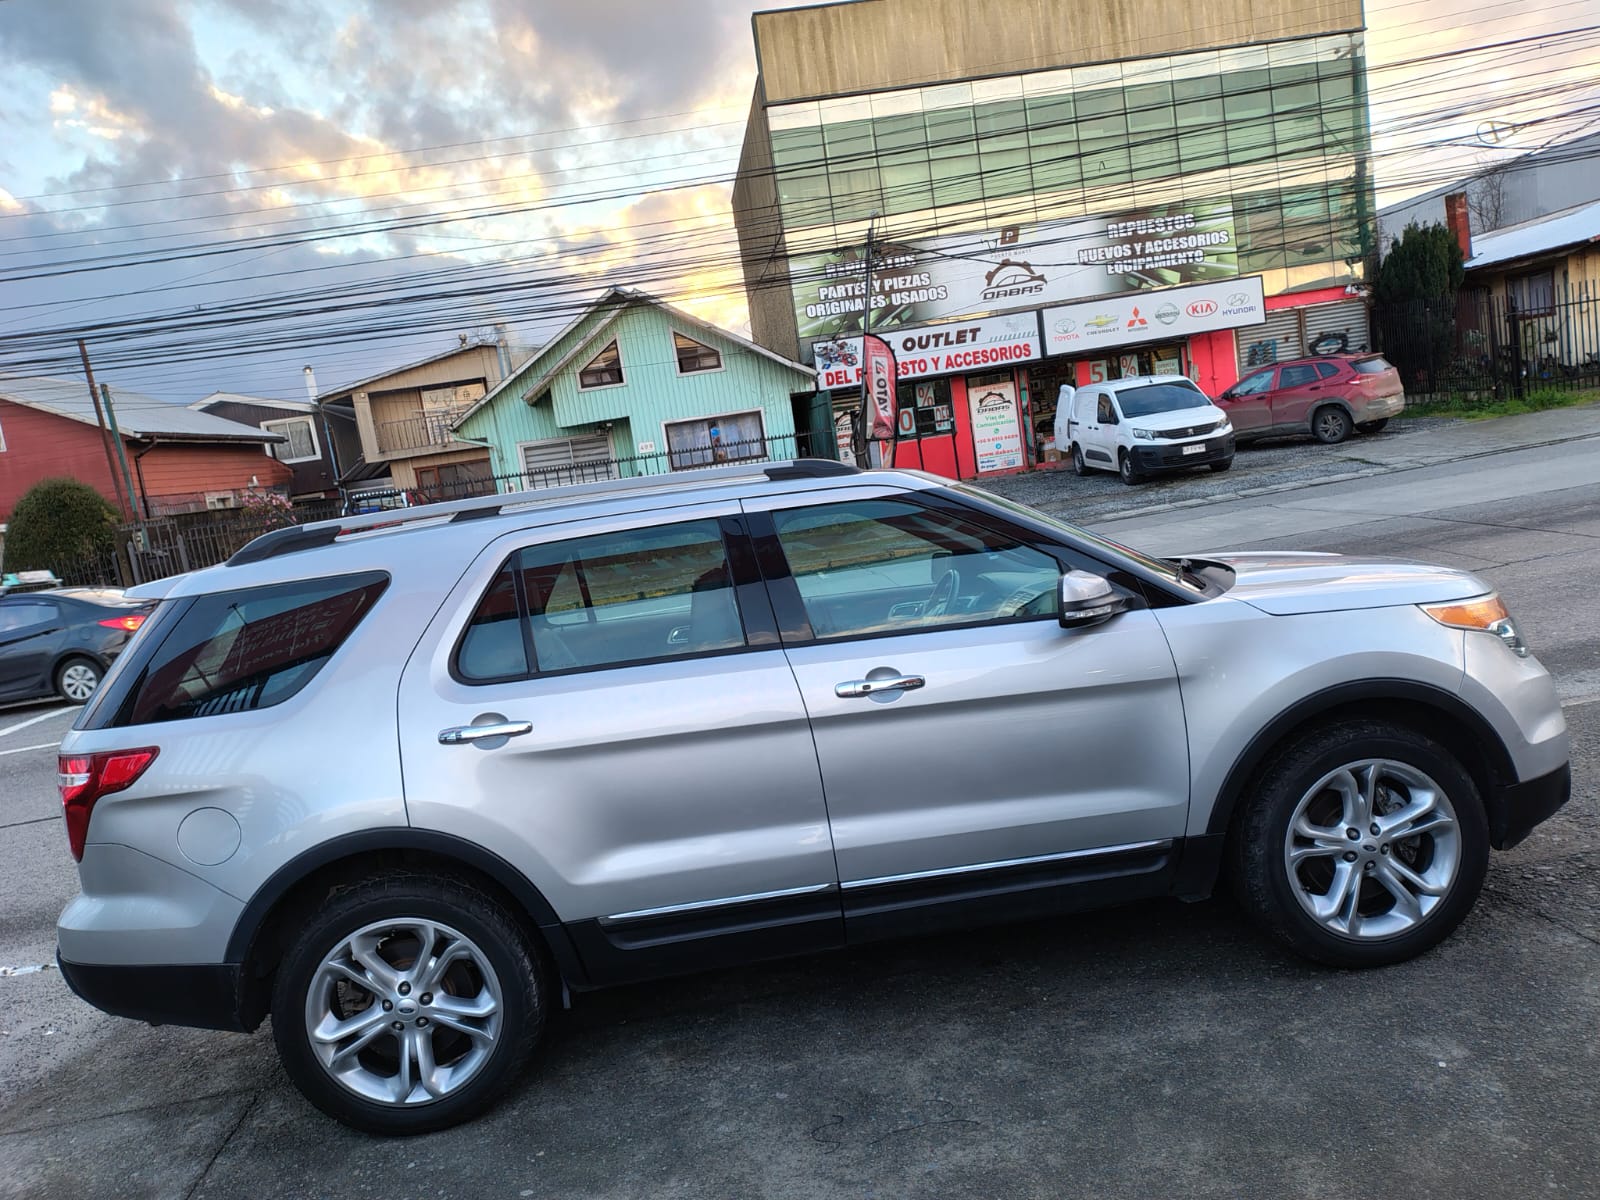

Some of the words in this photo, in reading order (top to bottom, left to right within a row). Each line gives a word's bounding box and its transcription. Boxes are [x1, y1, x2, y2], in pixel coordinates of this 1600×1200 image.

[1107, 213, 1195, 238] REPUESTOS
[1078, 244, 1131, 263] NUEVOS
[1133, 242, 1142, 255] Y
[1144, 230, 1229, 254] ACCESORIOS
[1107, 249, 1204, 275] EQUIPAMIENTO
[819, 281, 867, 300] PARTES
[872, 279, 882, 293] Y
[884, 273, 930, 290] PIEZAS
[982, 284, 1044, 300] DABAS
[806, 294, 887, 318] ORIGINAES
[891, 286, 947, 306] USADOS
[1191, 303, 1213, 315] KIA
[1222, 305, 1257, 316] HYUNDAI
[902, 327, 981, 351] OUTLET
[1053, 334, 1080, 343] TOYOTA
[825, 369, 851, 386] DEL
[931, 356, 940, 370] Y
[944, 343, 1031, 369] ACCESORIOS
